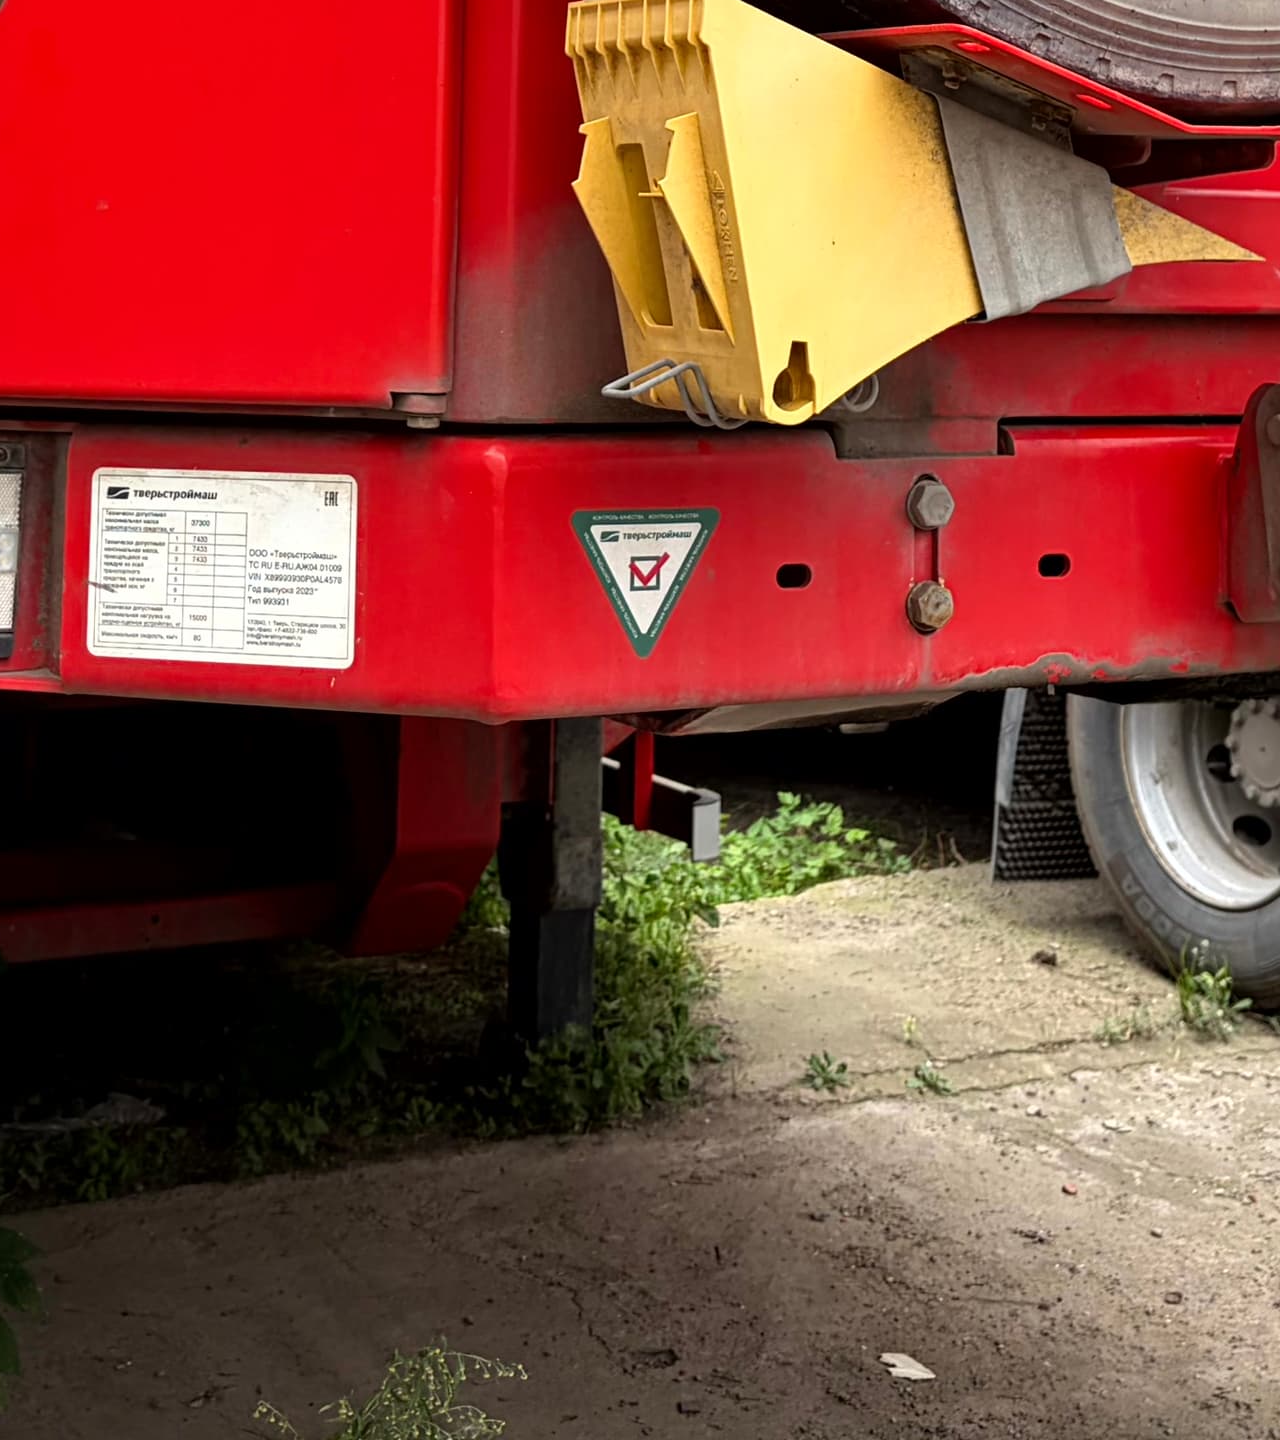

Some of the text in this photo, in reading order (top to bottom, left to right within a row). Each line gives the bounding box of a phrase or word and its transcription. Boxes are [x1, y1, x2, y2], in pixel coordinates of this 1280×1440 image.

[133, 489, 218, 501] тверьстроймаш
[191, 519, 211, 527] 37300
[193, 535, 208, 543] 7433
[622, 529, 692, 542] тверьстроймаш
[192, 545, 208, 553] 7433
[249, 549, 268, 557] ООО
[192, 555, 207, 563] 7433
[248, 585, 261, 594] Год
[189, 614, 208, 622] 15000
